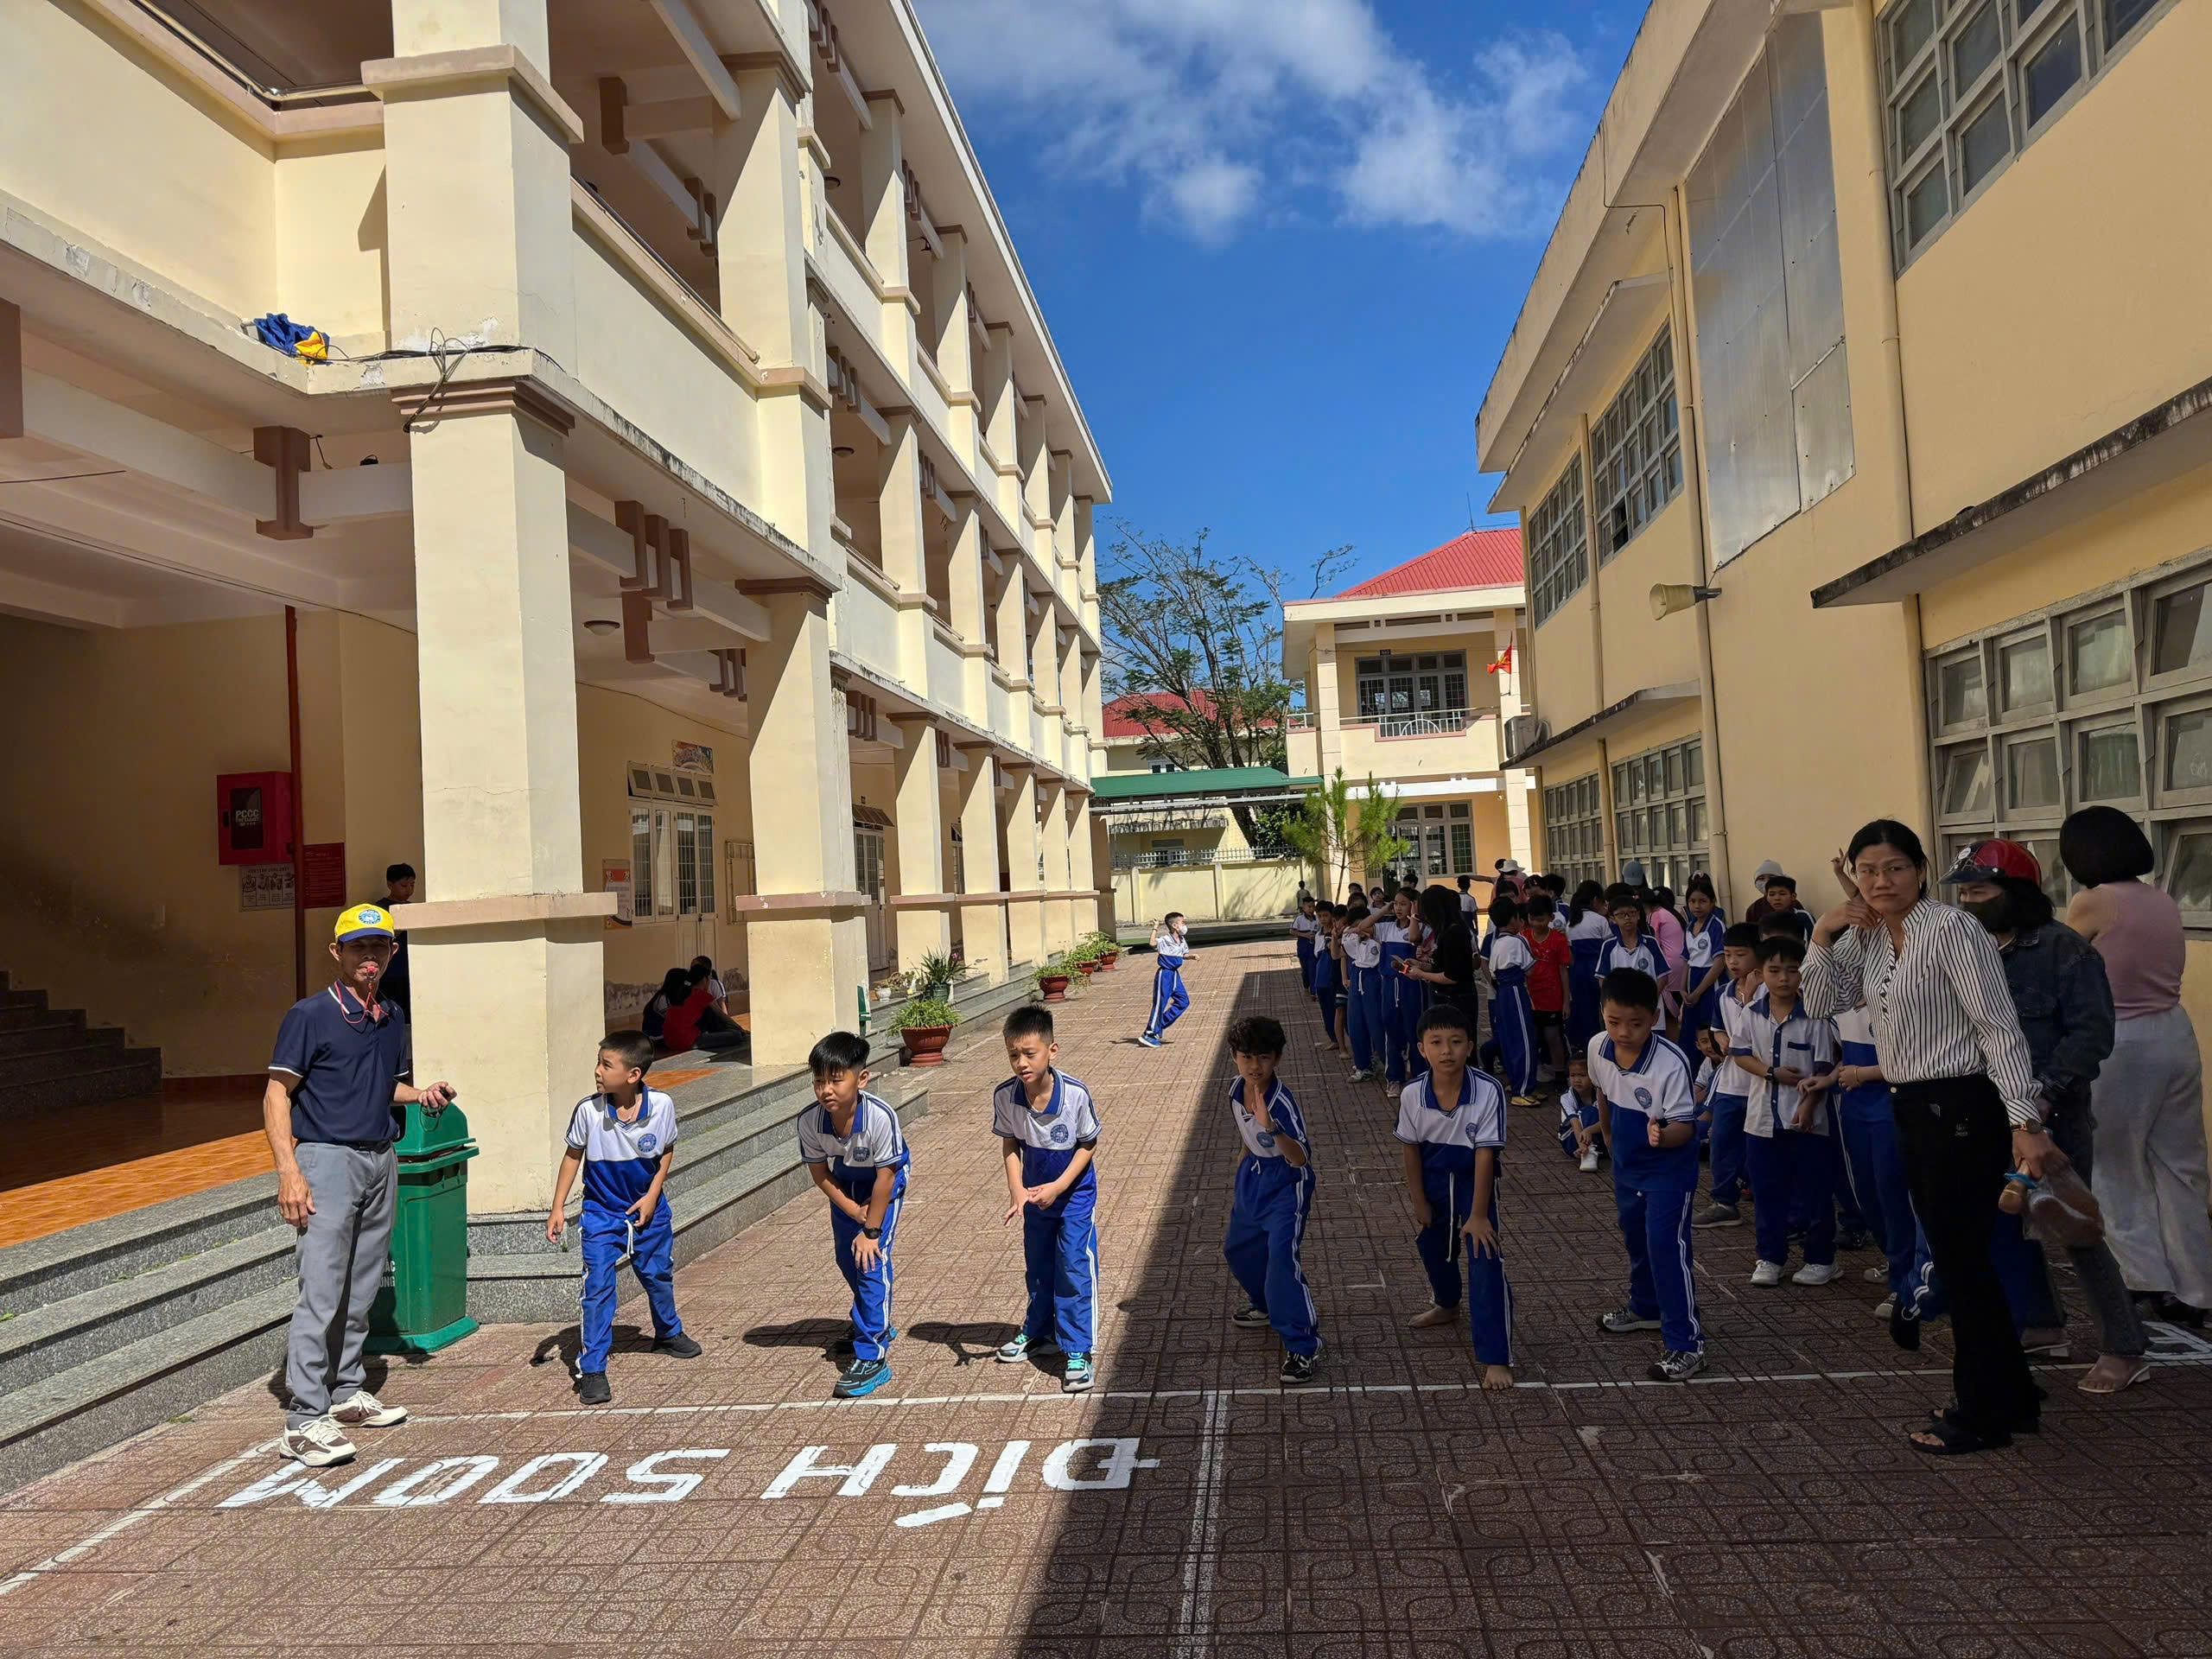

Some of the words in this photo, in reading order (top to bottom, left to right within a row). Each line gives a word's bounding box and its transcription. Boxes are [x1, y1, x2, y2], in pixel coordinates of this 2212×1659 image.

[235, 809, 259, 817] PCCC
[213, 1446, 731, 1508] 500M
[760, 1437, 1160, 1528] ĐÍCH
